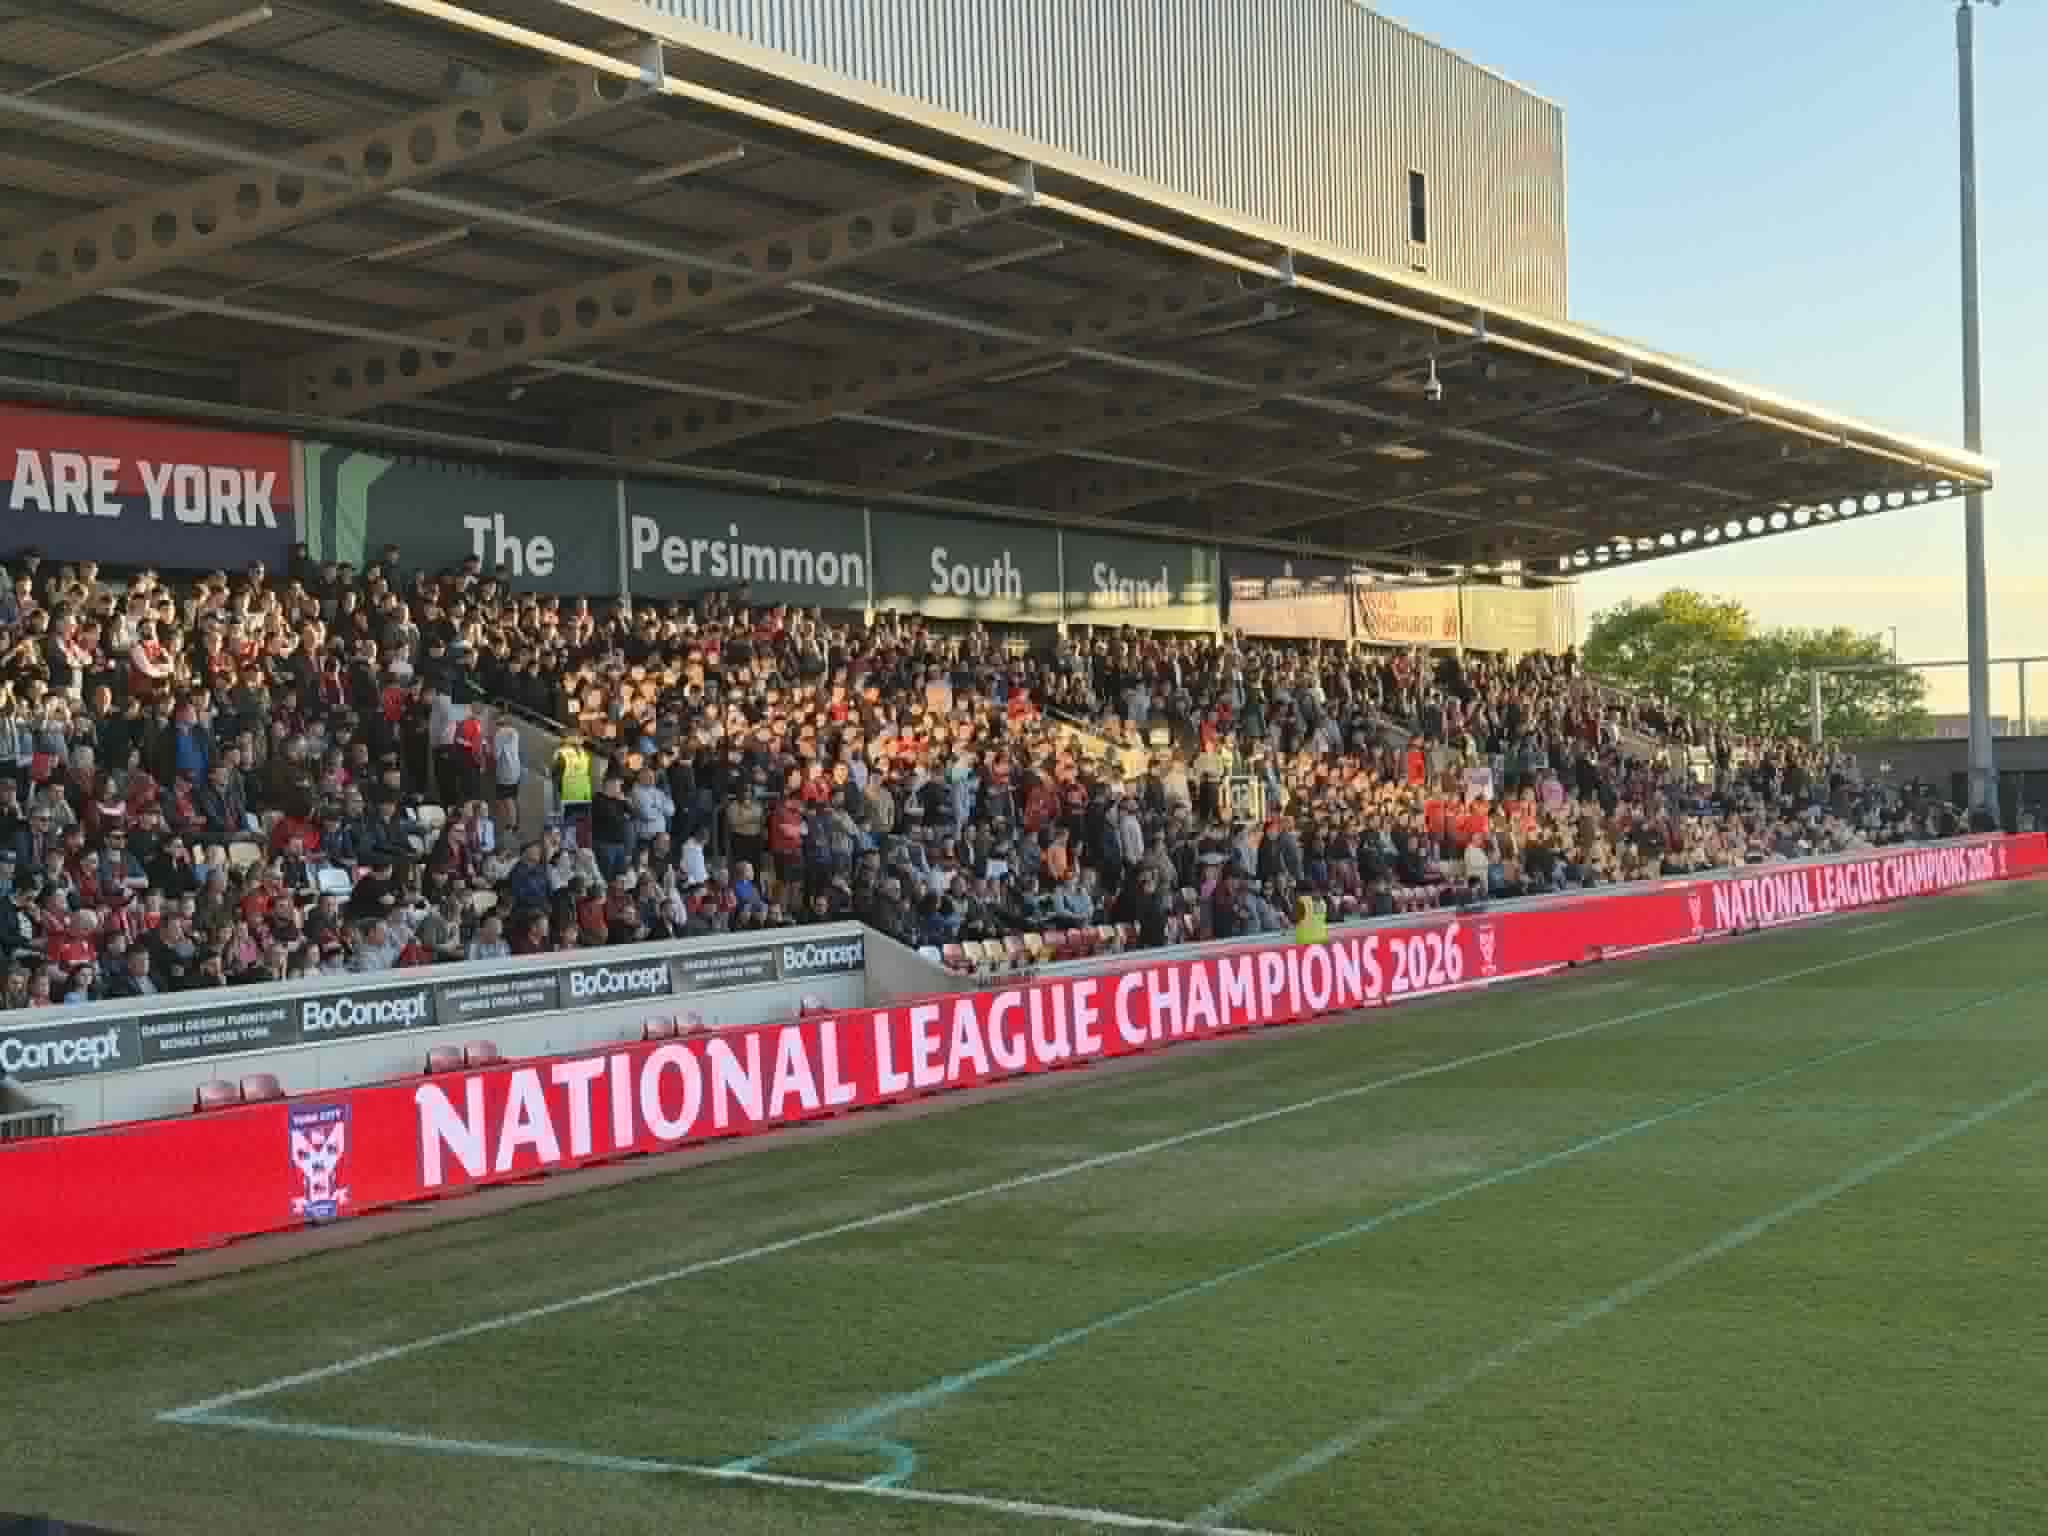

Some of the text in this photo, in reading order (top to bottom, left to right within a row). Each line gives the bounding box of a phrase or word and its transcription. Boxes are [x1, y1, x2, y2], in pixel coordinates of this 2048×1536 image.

[9, 448, 278, 529] ARE YORK
[464, 512, 555, 577] The
[631, 514, 864, 587] Persimmon
[931, 547, 1021, 599] South
[1093, 561, 1168, 608] Stand
[1712, 870, 1814, 929] NATIONAL
[1815, 861, 1881, 912] LEAGUE
[1884, 847, 1966, 897] CHAMPIONS
[570, 963, 669, 995] BoConcept
[784, 940, 864, 969] BoConcept
[303, 991, 427, 1032] BoConcept
[0, 1026, 121, 1072] Concept
[416, 922, 1462, 1187] NATIONAL LEAGUE CHAMPIONS 2026
